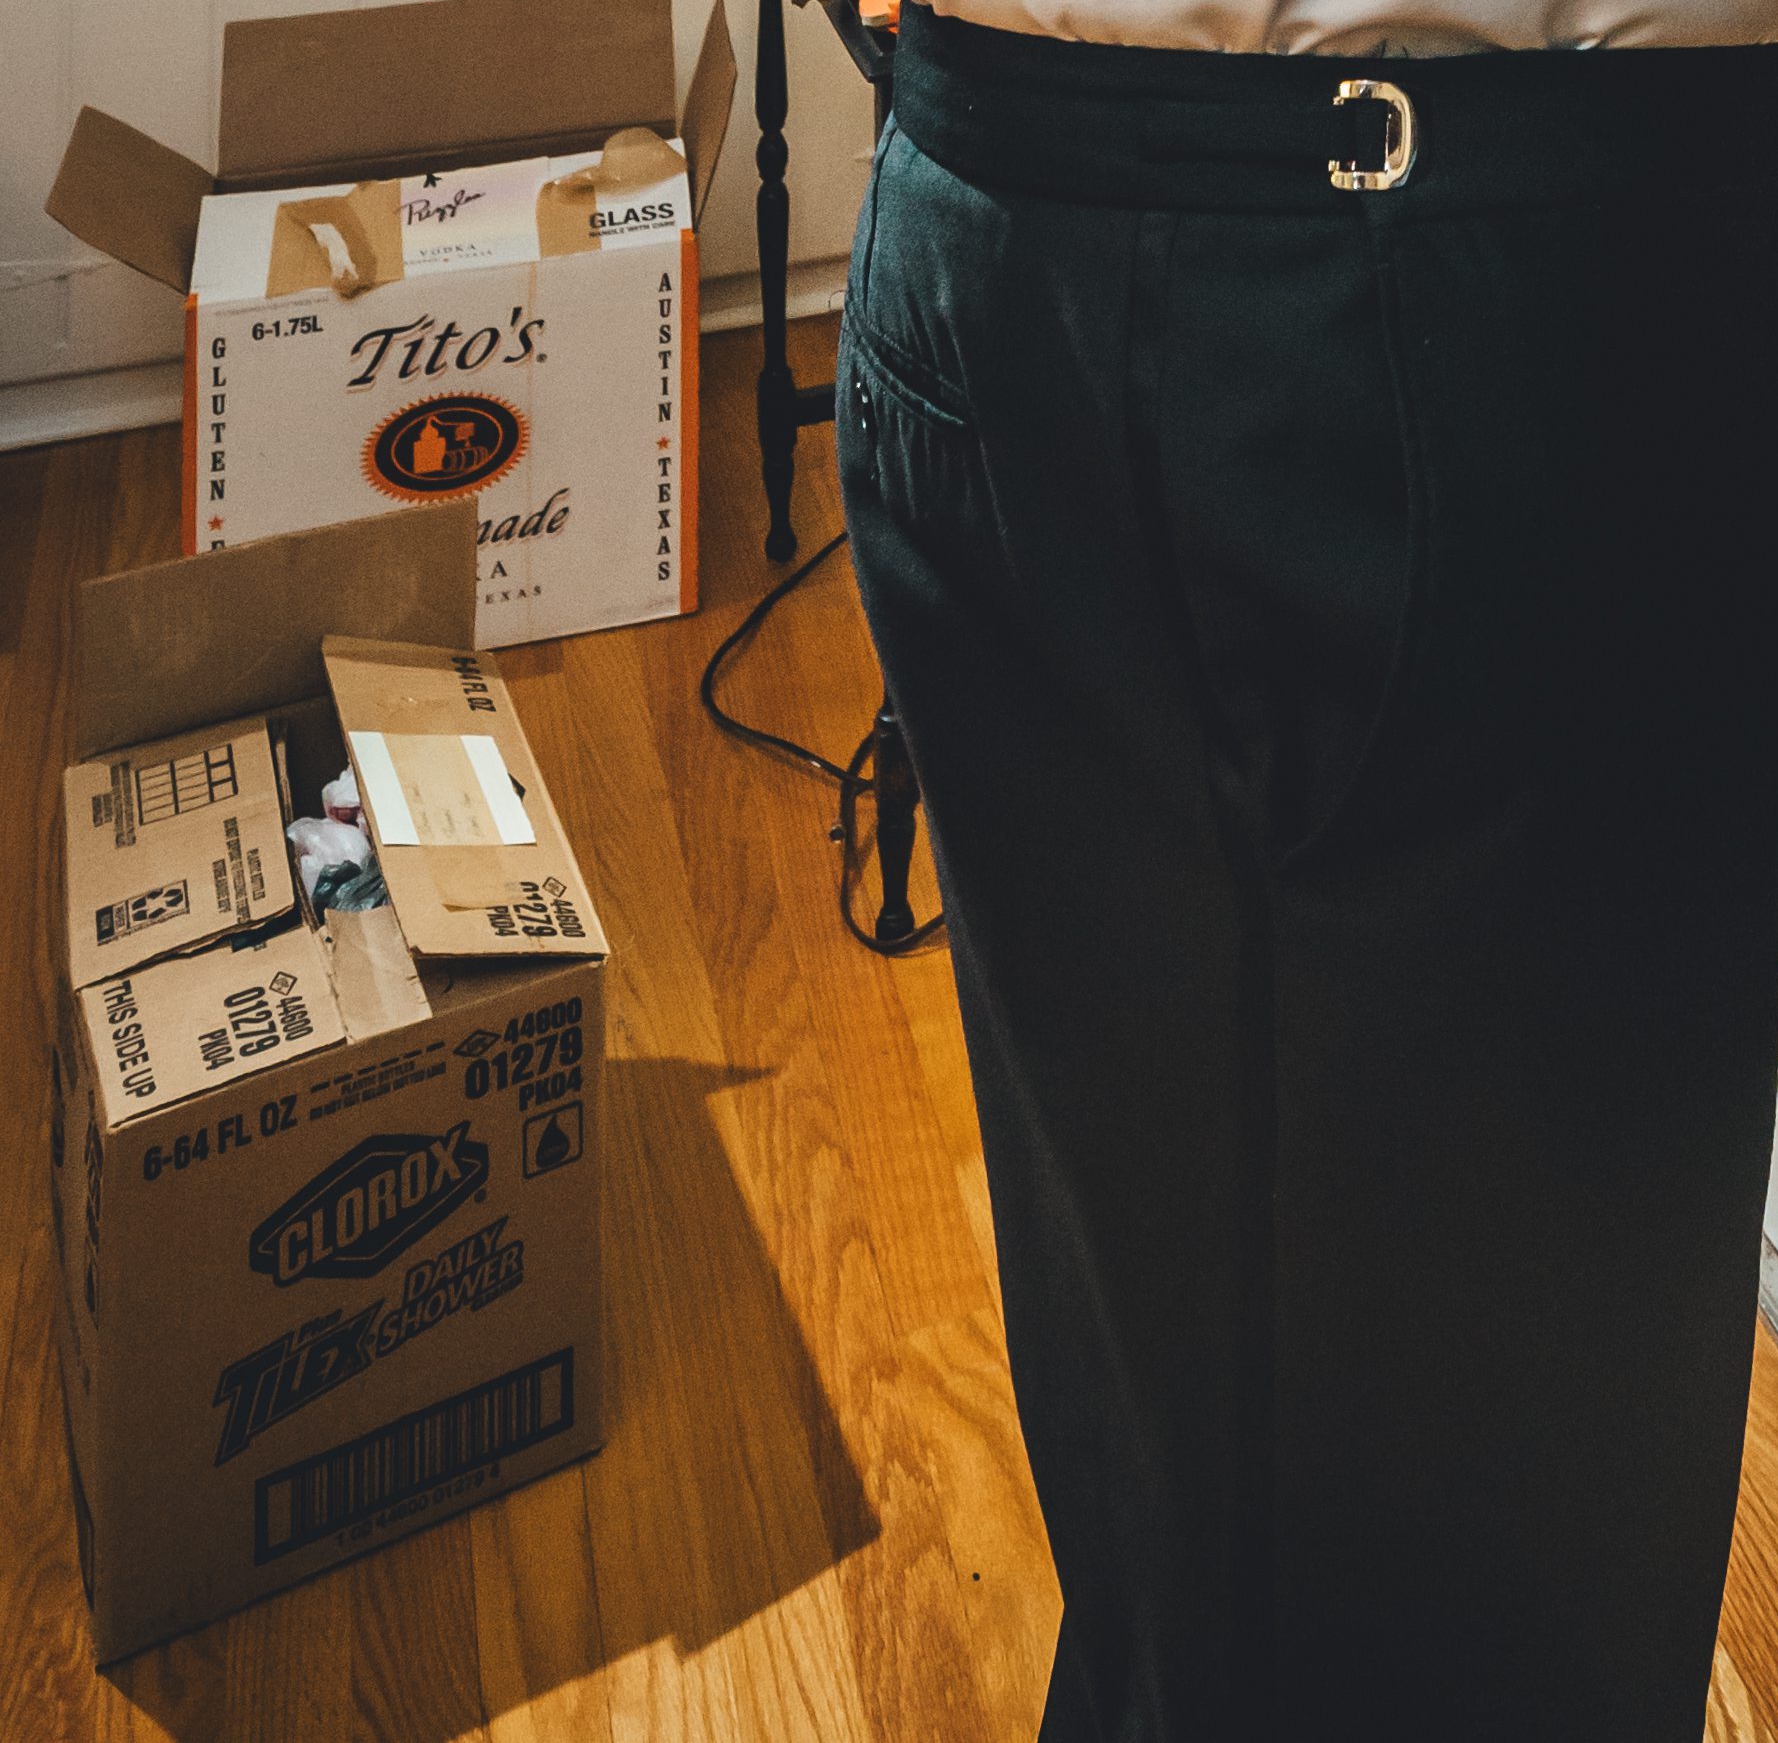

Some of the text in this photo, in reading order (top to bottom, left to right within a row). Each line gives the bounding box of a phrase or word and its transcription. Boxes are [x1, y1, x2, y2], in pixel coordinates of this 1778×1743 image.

[588, 202, 675, 229] GLASS
[252, 315, 324, 341] 6-1.75L
[346, 306, 545, 388] Tito's
[658, 272, 673, 423] AUSTIN
[210, 337, 227, 501] GLUTEN
[656, 456, 672, 581] TEXAS
[477, 584, 542, 604] EXAS
[466, 696, 497, 713] OZ
[102, 978, 157, 1099] THIS SIDE UP
[198, 1028, 235, 1071] PK04
[223, 985, 281, 1058] 01279
[275, 995, 314, 1042] 44600
[464, 1026, 583, 1100] 01279
[518, 1065, 583, 1112] PK04
[142, 1094, 299, 1181] 6-64 FL OZ
[275, 1120, 470, 1287] CLOROX
[378, 1243, 522, 1351] SHOWER
[405, 1221, 502, 1303] DAILY
